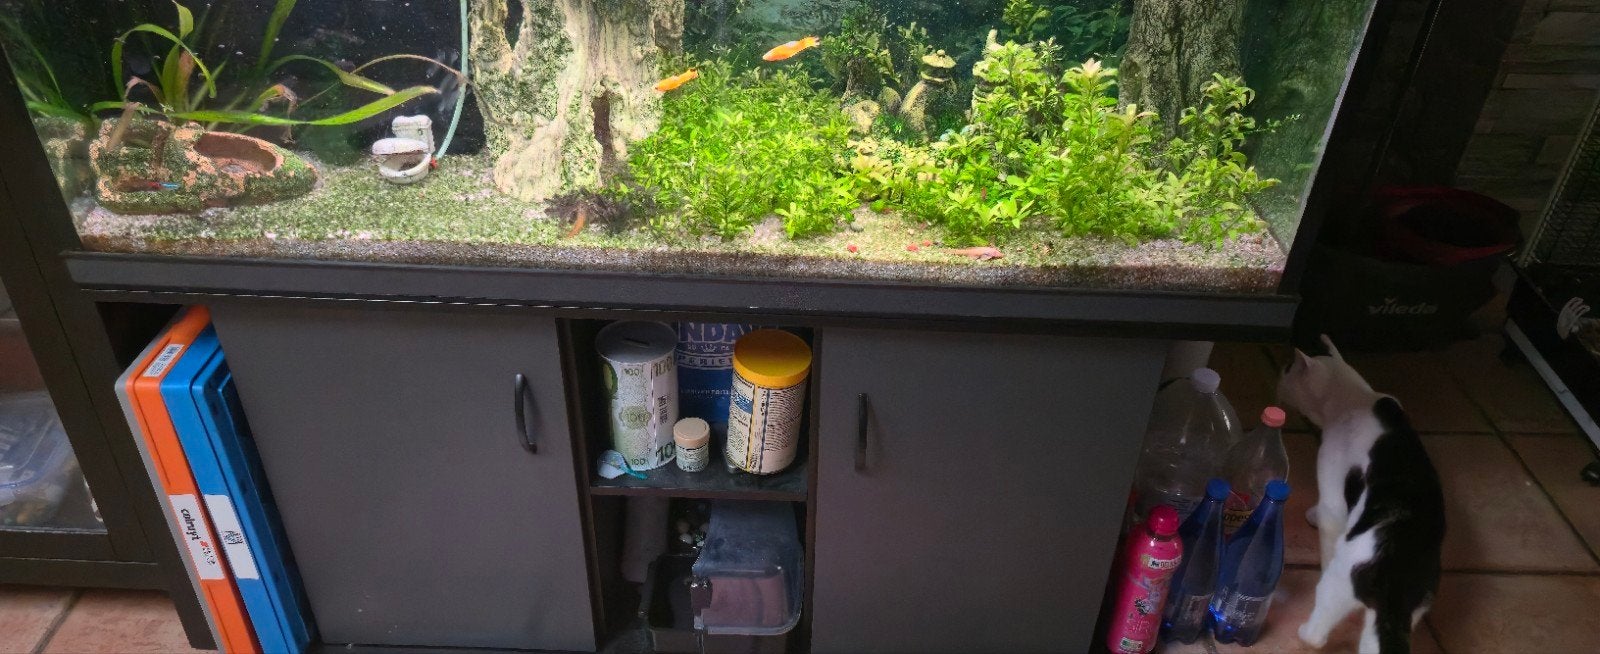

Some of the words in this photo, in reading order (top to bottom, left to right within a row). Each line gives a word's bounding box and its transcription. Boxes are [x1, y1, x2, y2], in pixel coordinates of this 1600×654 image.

[1368, 297, 1438, 315] vileda
[653, 356, 673, 376] 100
[631, 458, 646, 466] 100
[181, 508, 201, 542] colruyt
